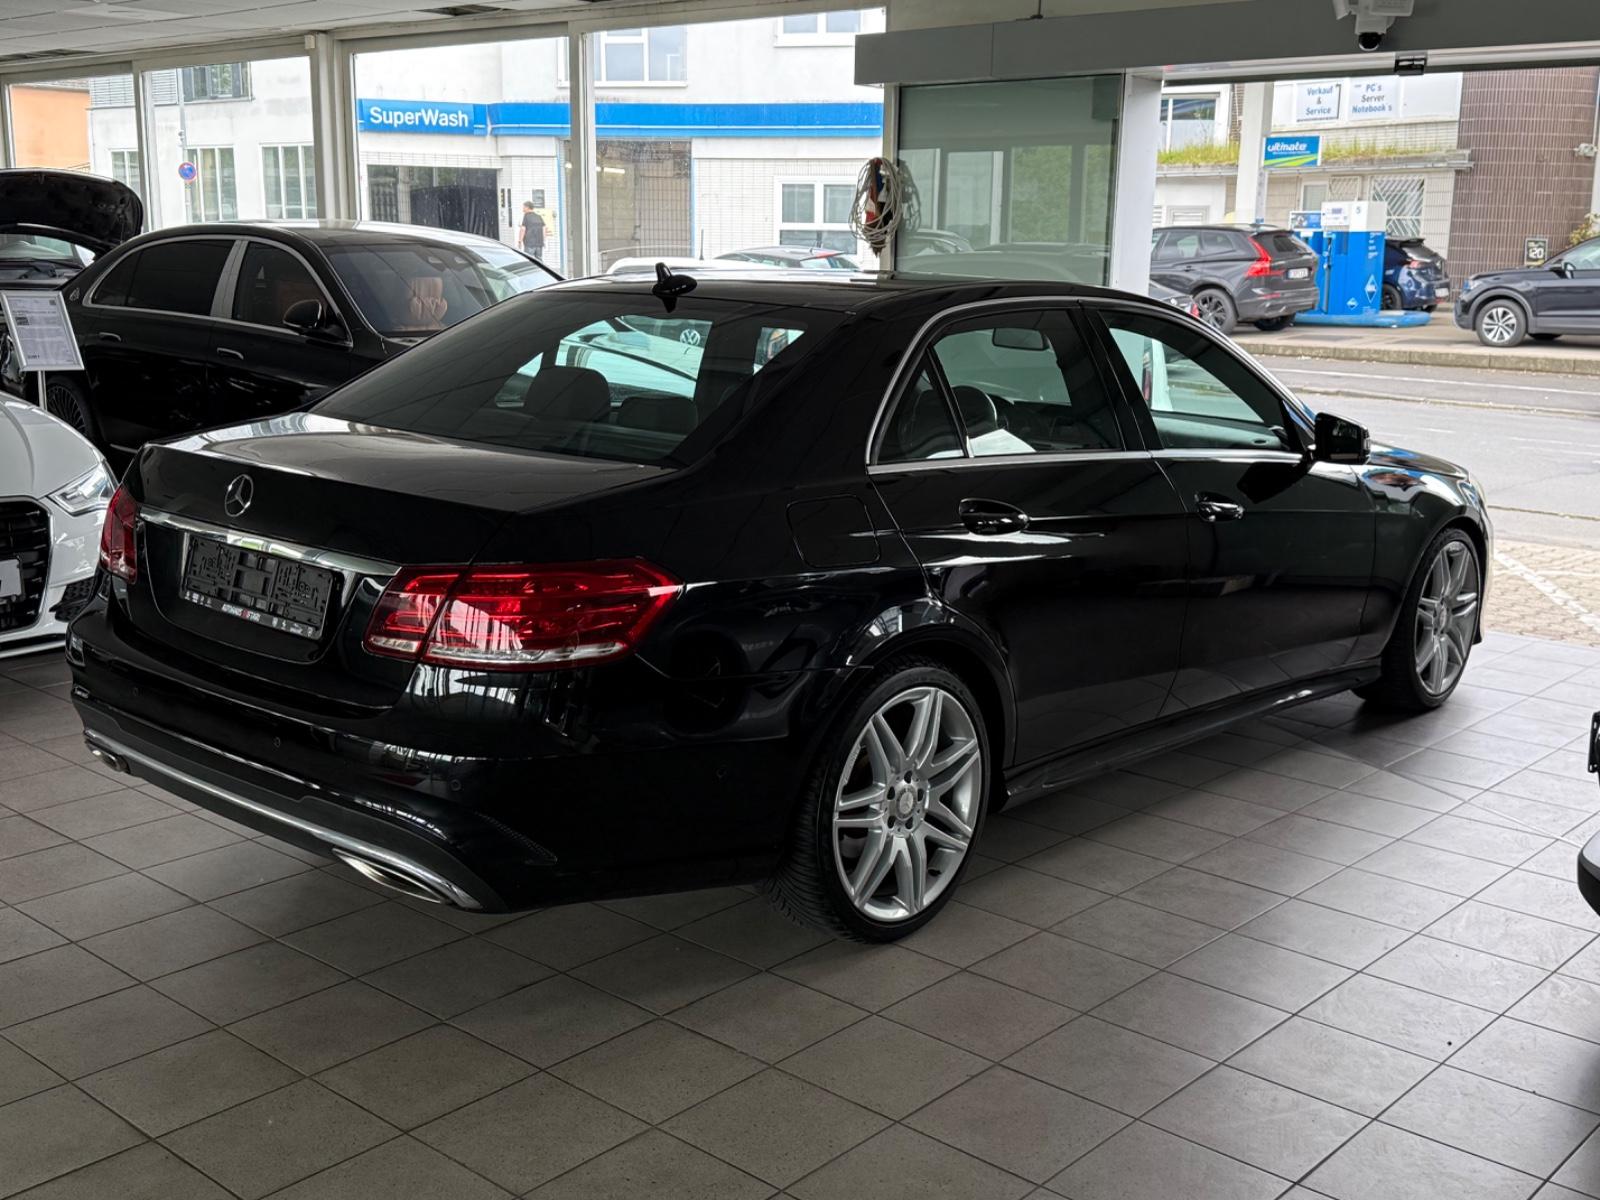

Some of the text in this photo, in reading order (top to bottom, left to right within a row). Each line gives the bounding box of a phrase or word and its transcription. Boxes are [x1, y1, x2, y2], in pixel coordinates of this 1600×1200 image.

[1307, 86, 1334, 96] Verkauf
[1316, 97, 1322, 105] &
[1361, 93, 1385, 103] Server
[370, 106, 468, 127] SuperWash
[1306, 107, 1331, 116] Service
[1267, 141, 1308, 152] ultimate
